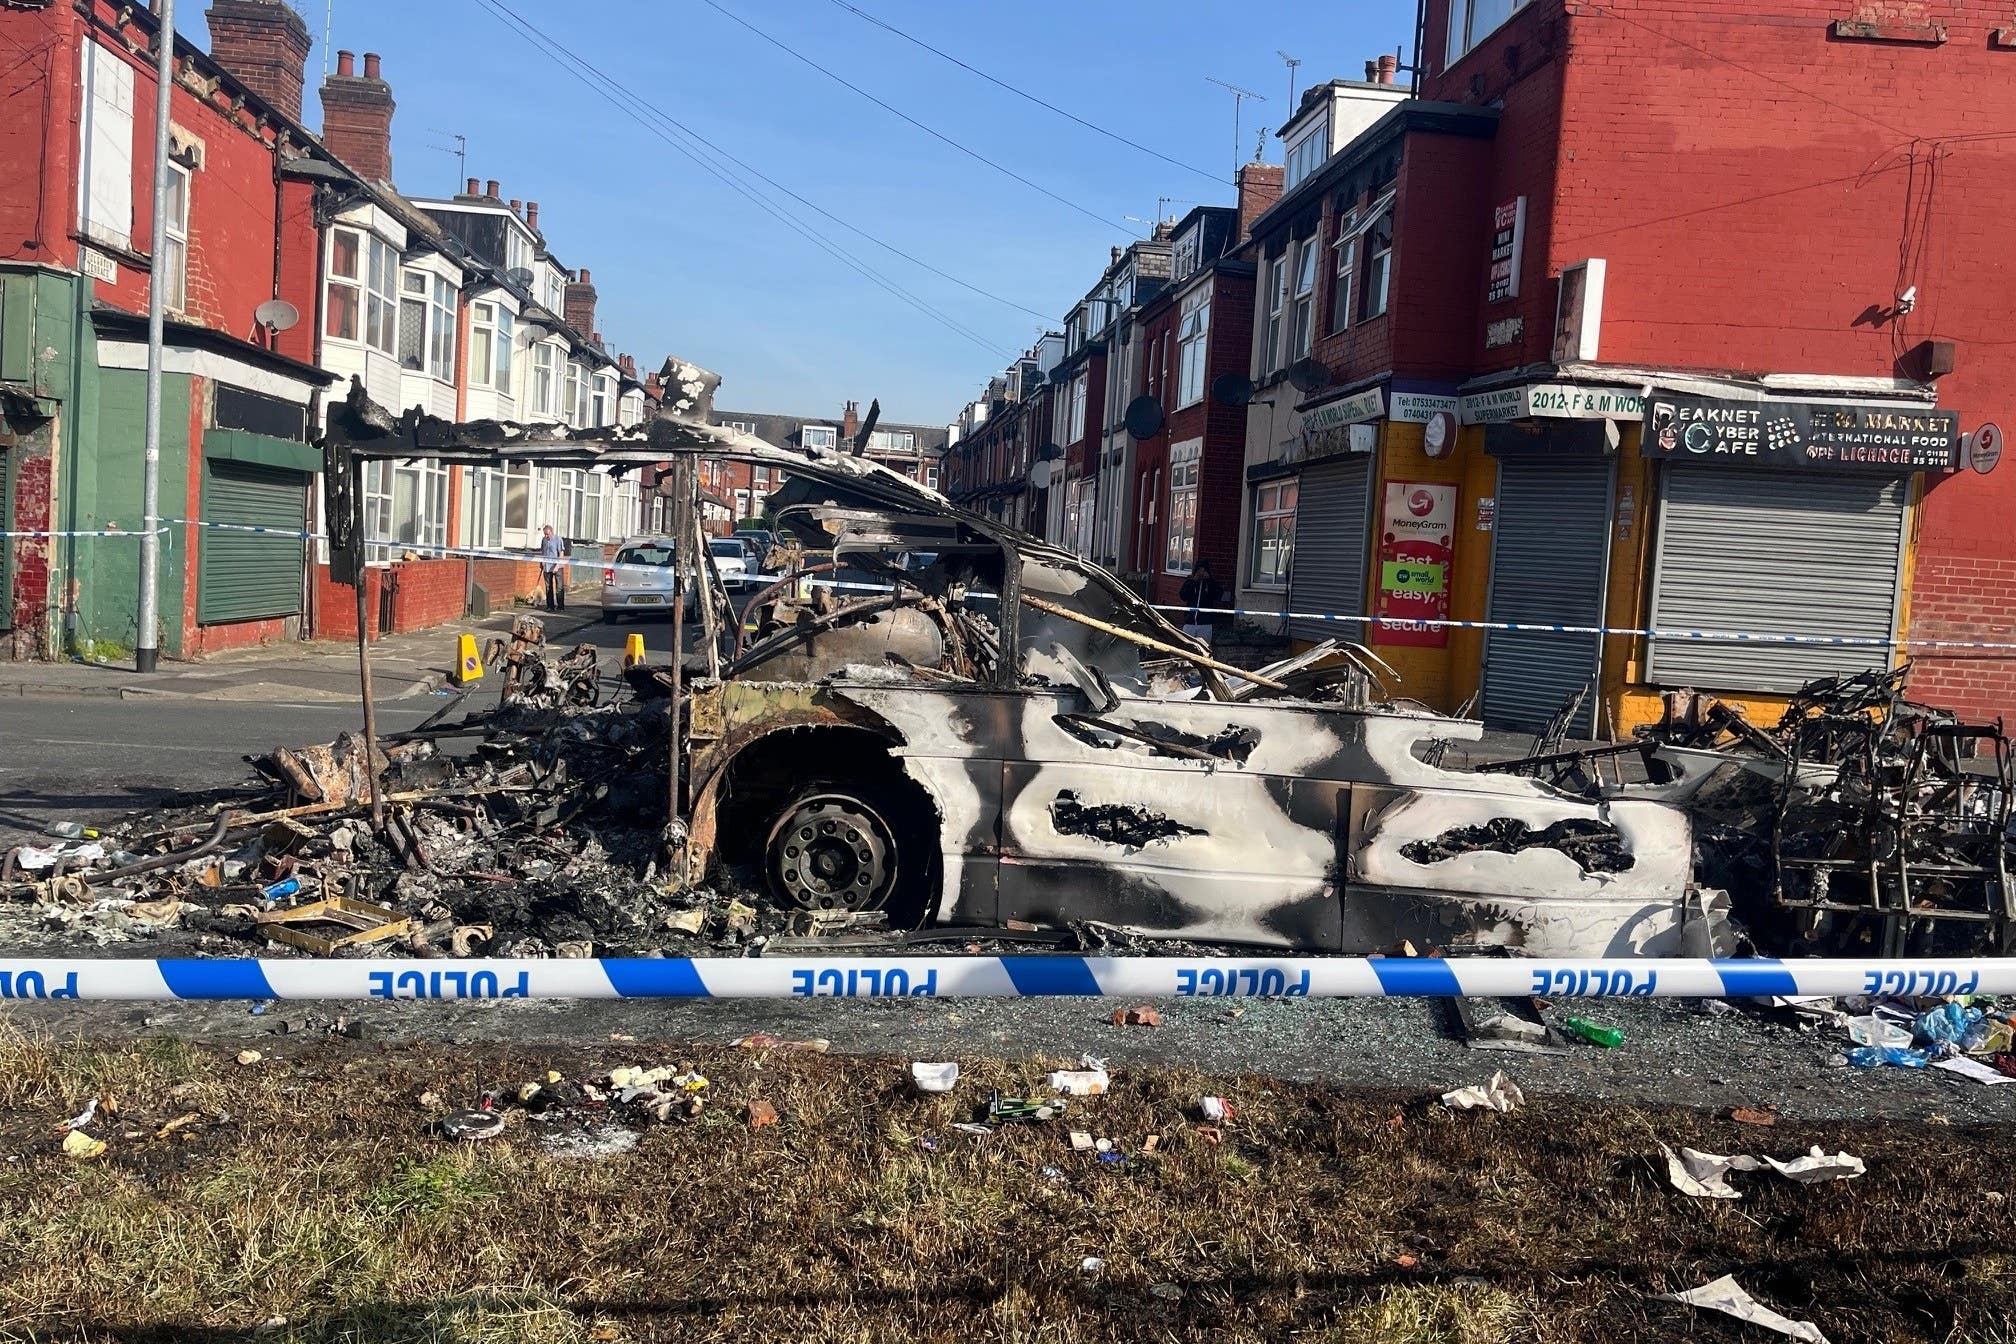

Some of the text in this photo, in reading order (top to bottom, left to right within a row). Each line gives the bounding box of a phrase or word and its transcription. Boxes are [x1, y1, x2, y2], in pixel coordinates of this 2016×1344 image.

[1412, 397, 1457, 411] 07533473477
[1499, 390, 1522, 404] WORLD
[1572, 394, 1580, 409] F
[1584, 394, 1594, 411] &
[1599, 395, 1611, 412] M
[1474, 405, 1519, 421] SUPERMARKET
[1865, 413, 1951, 433] MARKET
[1912, 436, 1948, 447] FOOD
[1392, 518, 1447, 531] MoneyGram
[1411, 570, 1429, 578] small
[1415, 575, 1435, 583] world
[369, 970, 529, 999] POLICE
[792, 968, 938, 997] POLICE
[1176, 968, 1311, 997] POLICE
[1531, 968, 1657, 997] POLICE
[1863, 969, 1979, 997] POLICE
